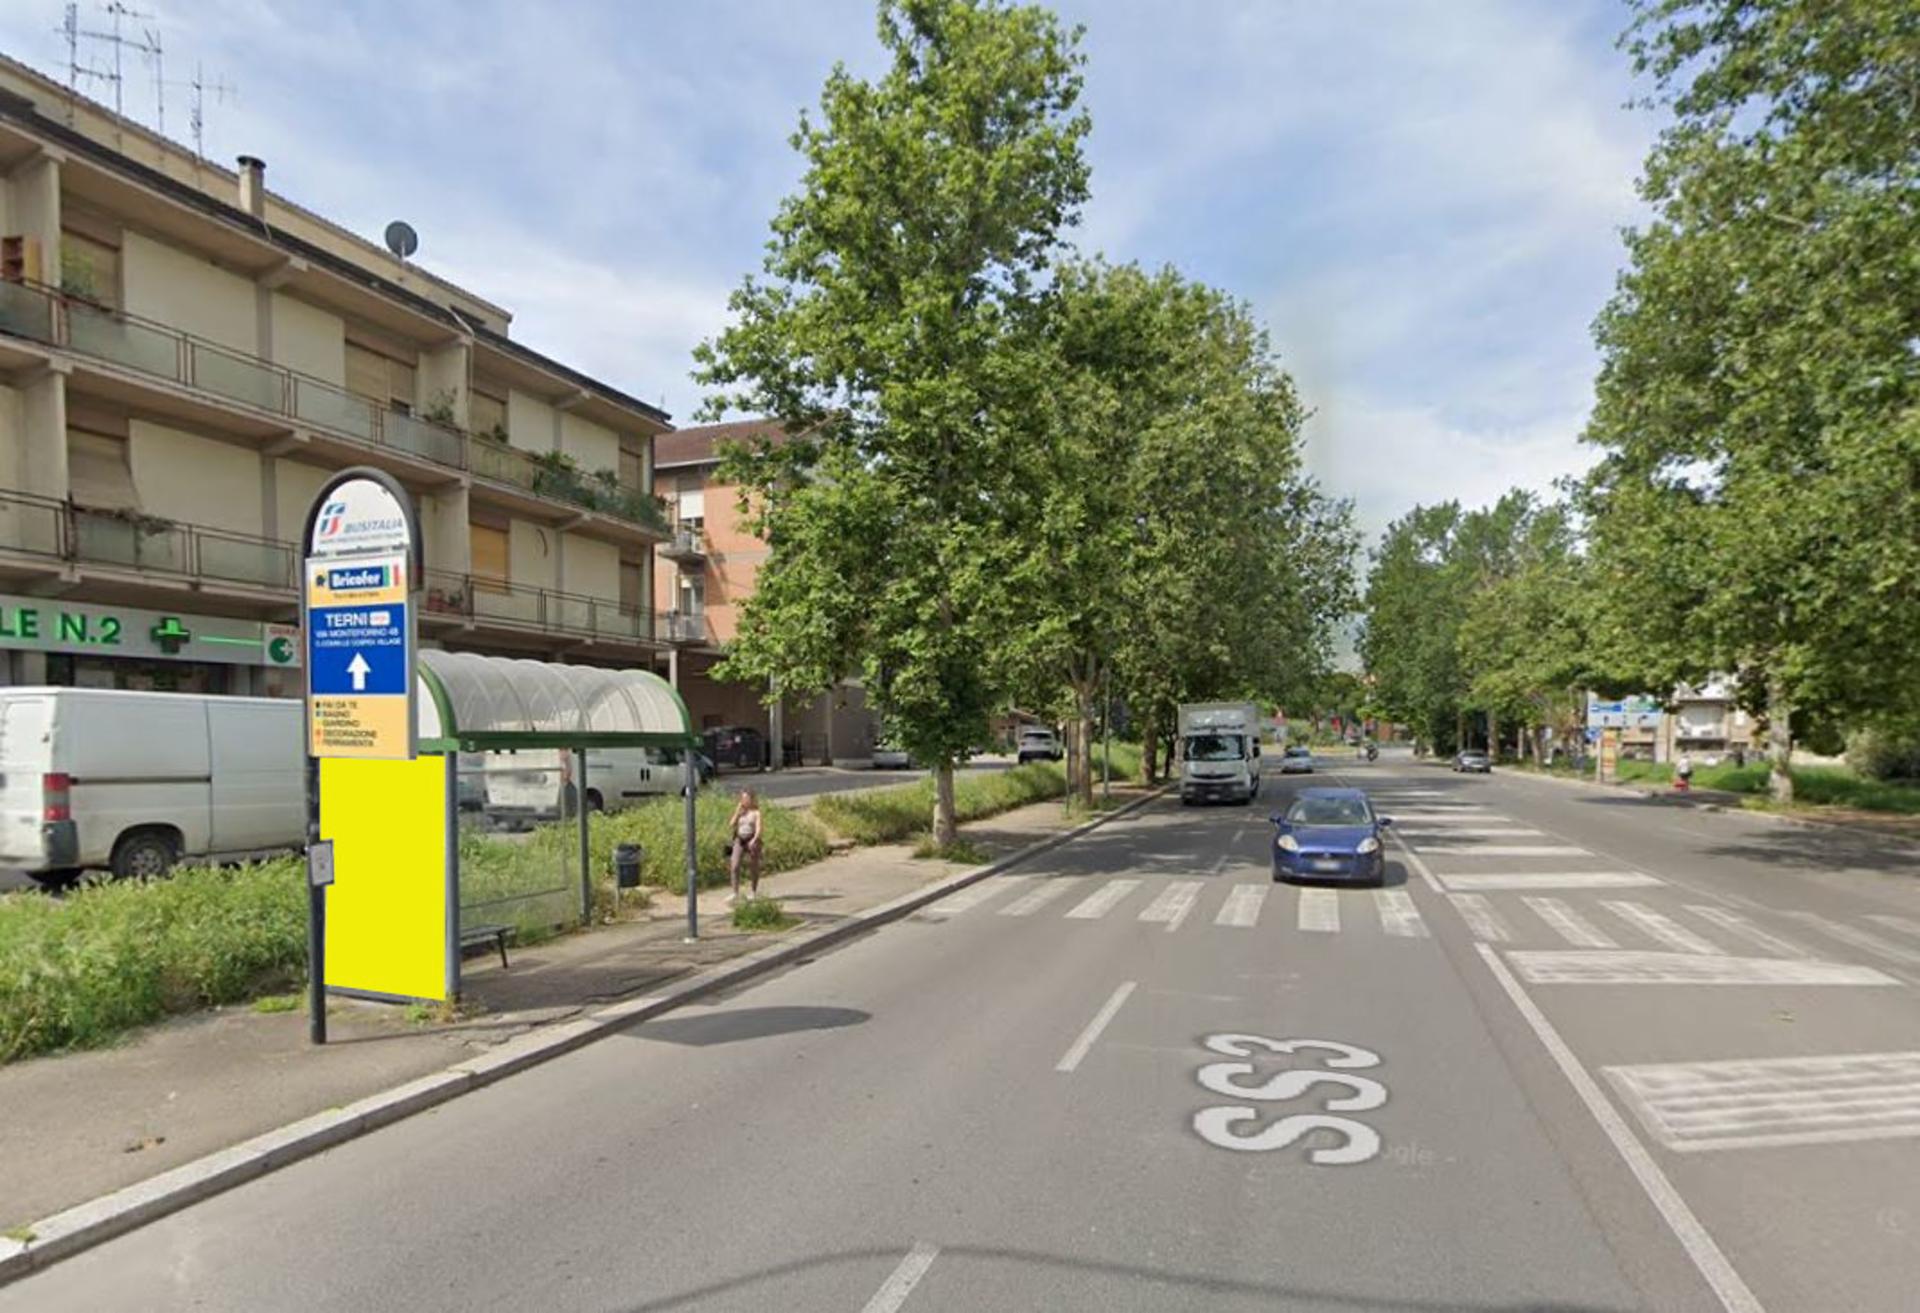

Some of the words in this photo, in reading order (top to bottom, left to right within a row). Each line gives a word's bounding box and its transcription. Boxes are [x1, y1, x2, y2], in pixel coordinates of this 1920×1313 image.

[332, 570, 381, 588] Bricofer
[58, 611, 121, 645] N.2
[325, 611, 368, 627] TERNI
